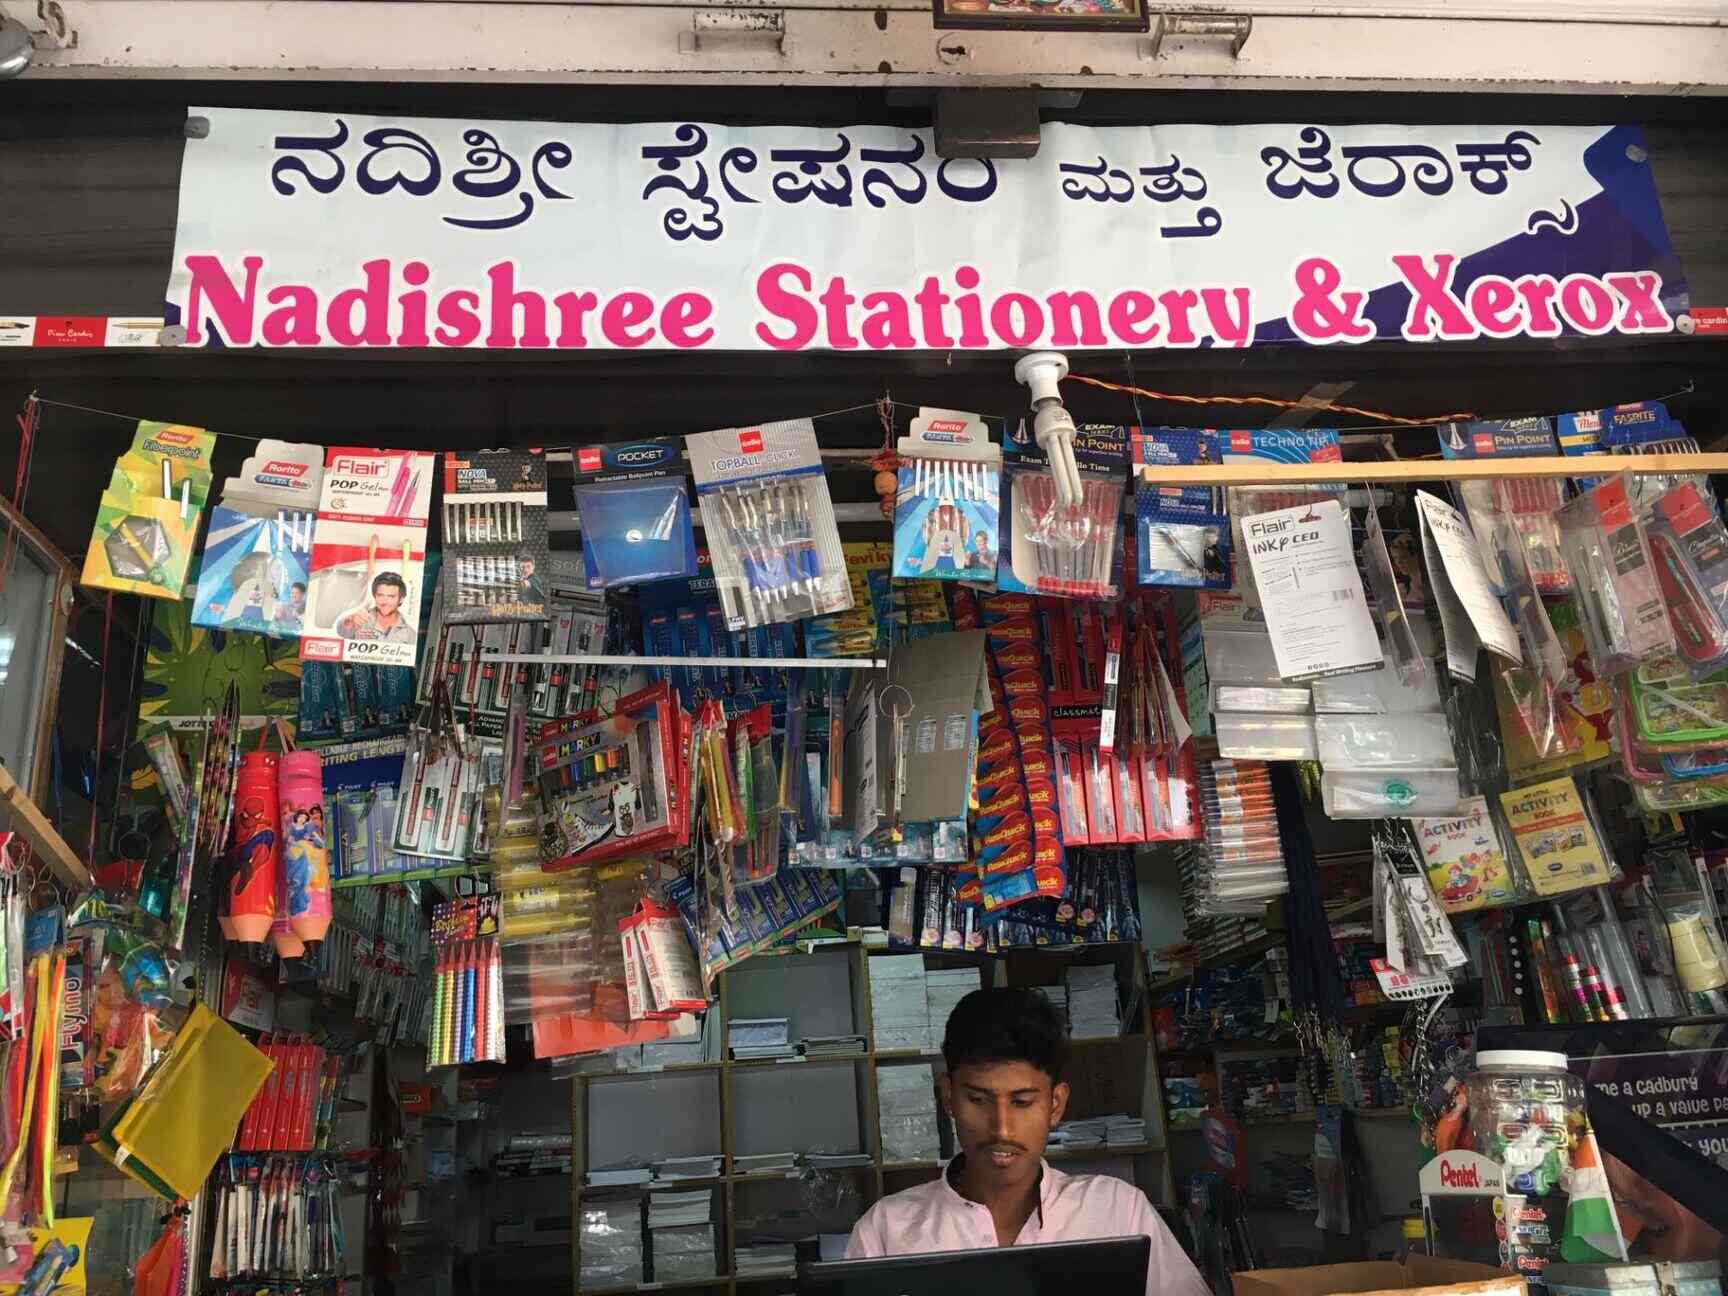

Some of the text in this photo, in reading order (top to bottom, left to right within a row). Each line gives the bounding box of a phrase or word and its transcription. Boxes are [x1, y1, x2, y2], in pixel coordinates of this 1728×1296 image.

[271, 118, 575, 230] ನದಿಶ್ರೀ
[1060, 154, 1223, 238] ಮತ್ತು
[185, 254, 1668, 352] Nadishree Stationery & Xerox
[1071, 439, 1085, 448] IN
[1087, 438, 1126, 452] POINT
[1253, 436, 1305, 448] TECHNO
[1494, 435, 1515, 446] PIN
[1517, 433, 1551, 445] POINT
[617, 449, 665, 462] POCKET
[711, 455, 761, 472] TOPBALL
[337, 459, 388, 475] Flair
[330, 479, 359, 490] POP
[1251, 518, 1292, 536] Flair
[1292, 531, 1319, 544] CEO
[347, 642, 379, 654] POP
[1054, 706, 1103, 717] classmat
[1511, 790, 1568, 816] ACTIVITY
[1423, 815, 1481, 838] ACTIVITY
[1622, 1081, 1634, 1096] a
[1635, 1070, 1699, 1095] cadbury
[1655, 1101, 1666, 1117] a
[1669, 1098, 1710, 1116] value
[1440, 1159, 1480, 1188] Pentel
